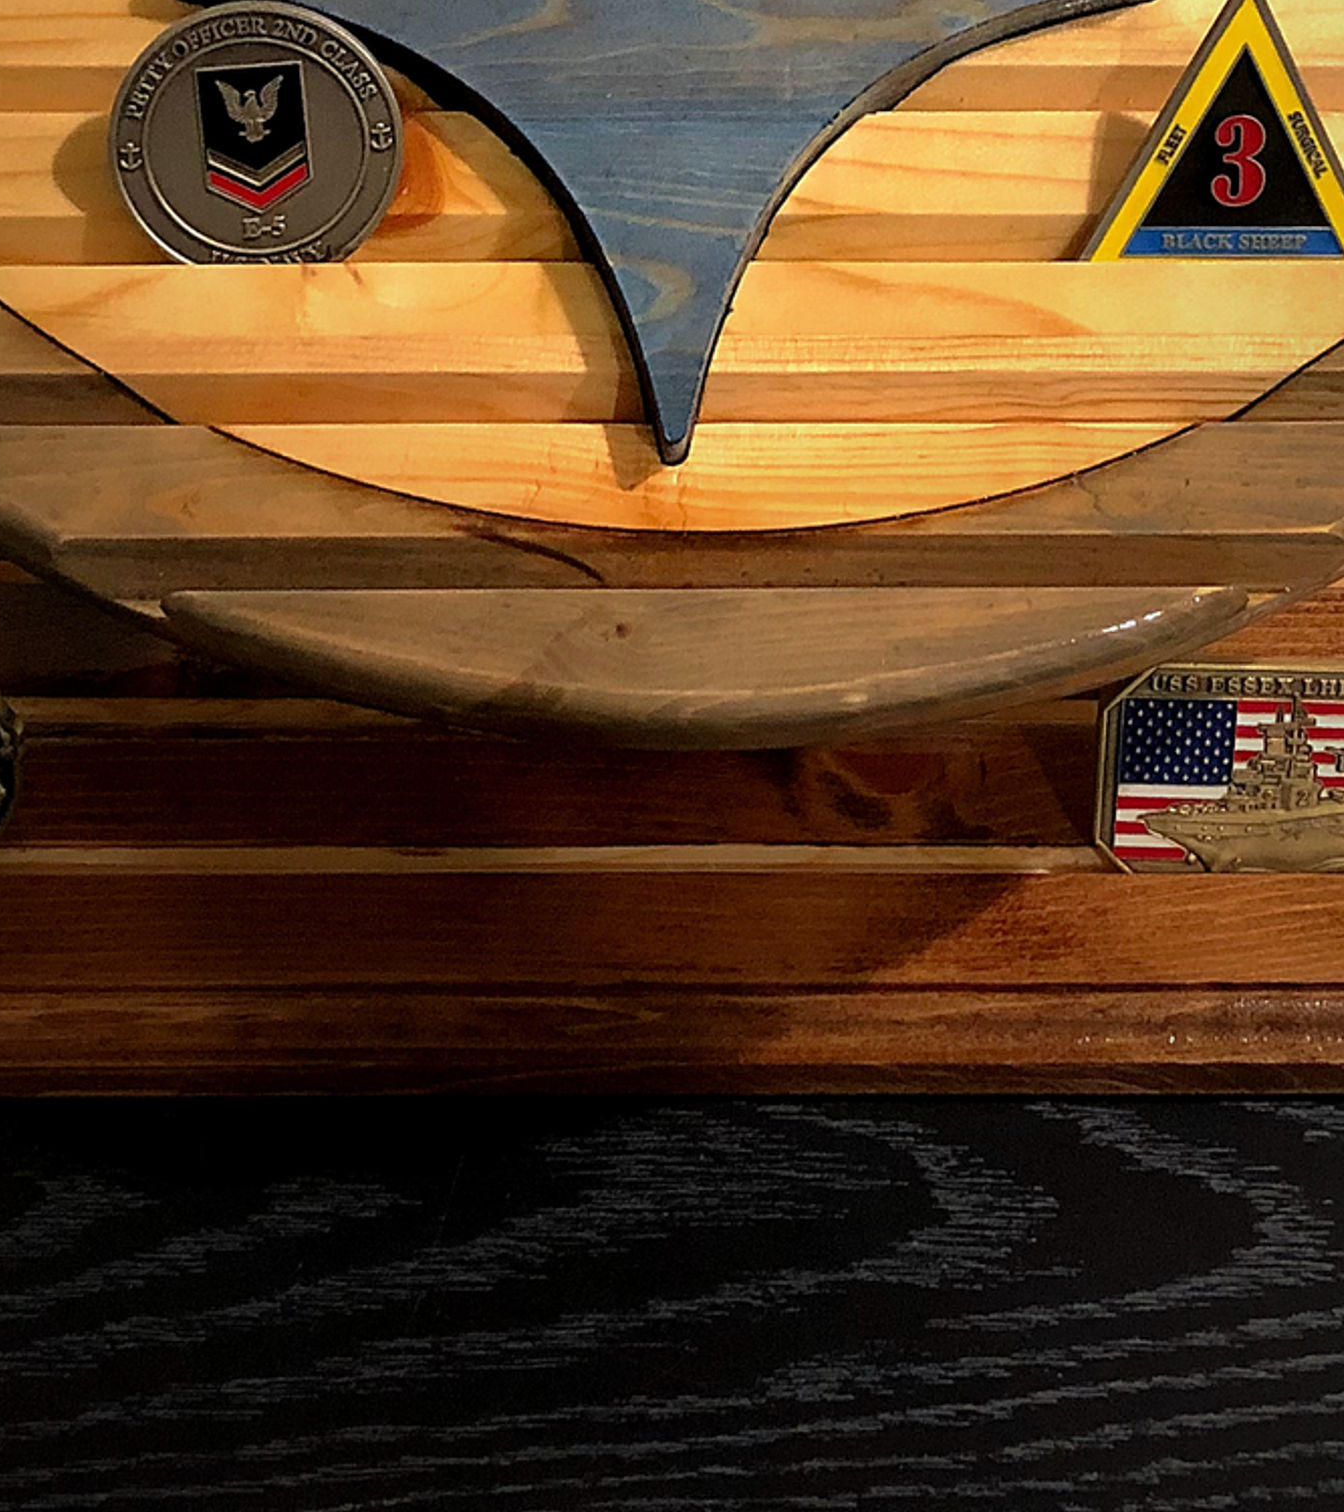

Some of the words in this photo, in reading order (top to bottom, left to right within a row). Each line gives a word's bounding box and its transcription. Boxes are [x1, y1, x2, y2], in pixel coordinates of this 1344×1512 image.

[125, 54, 174, 121] PETTY
[172, 17, 269, 58] OFFICER
[273, 20, 317, 46] 2ND
[321, 39, 379, 101] CLASS
[1155, 123, 1188, 167] FLEET
[1210, 114, 1267, 208] 3
[1287, 110, 1330, 180] SURGICAL
[241, 214, 287, 239] E-5
[1161, 233, 1234, 249] BLACK
[1238, 233, 1307, 250] SHEEP
[1151, 675, 1199, 693] USS
[1210, 676, 1295, 695] ESSEX
